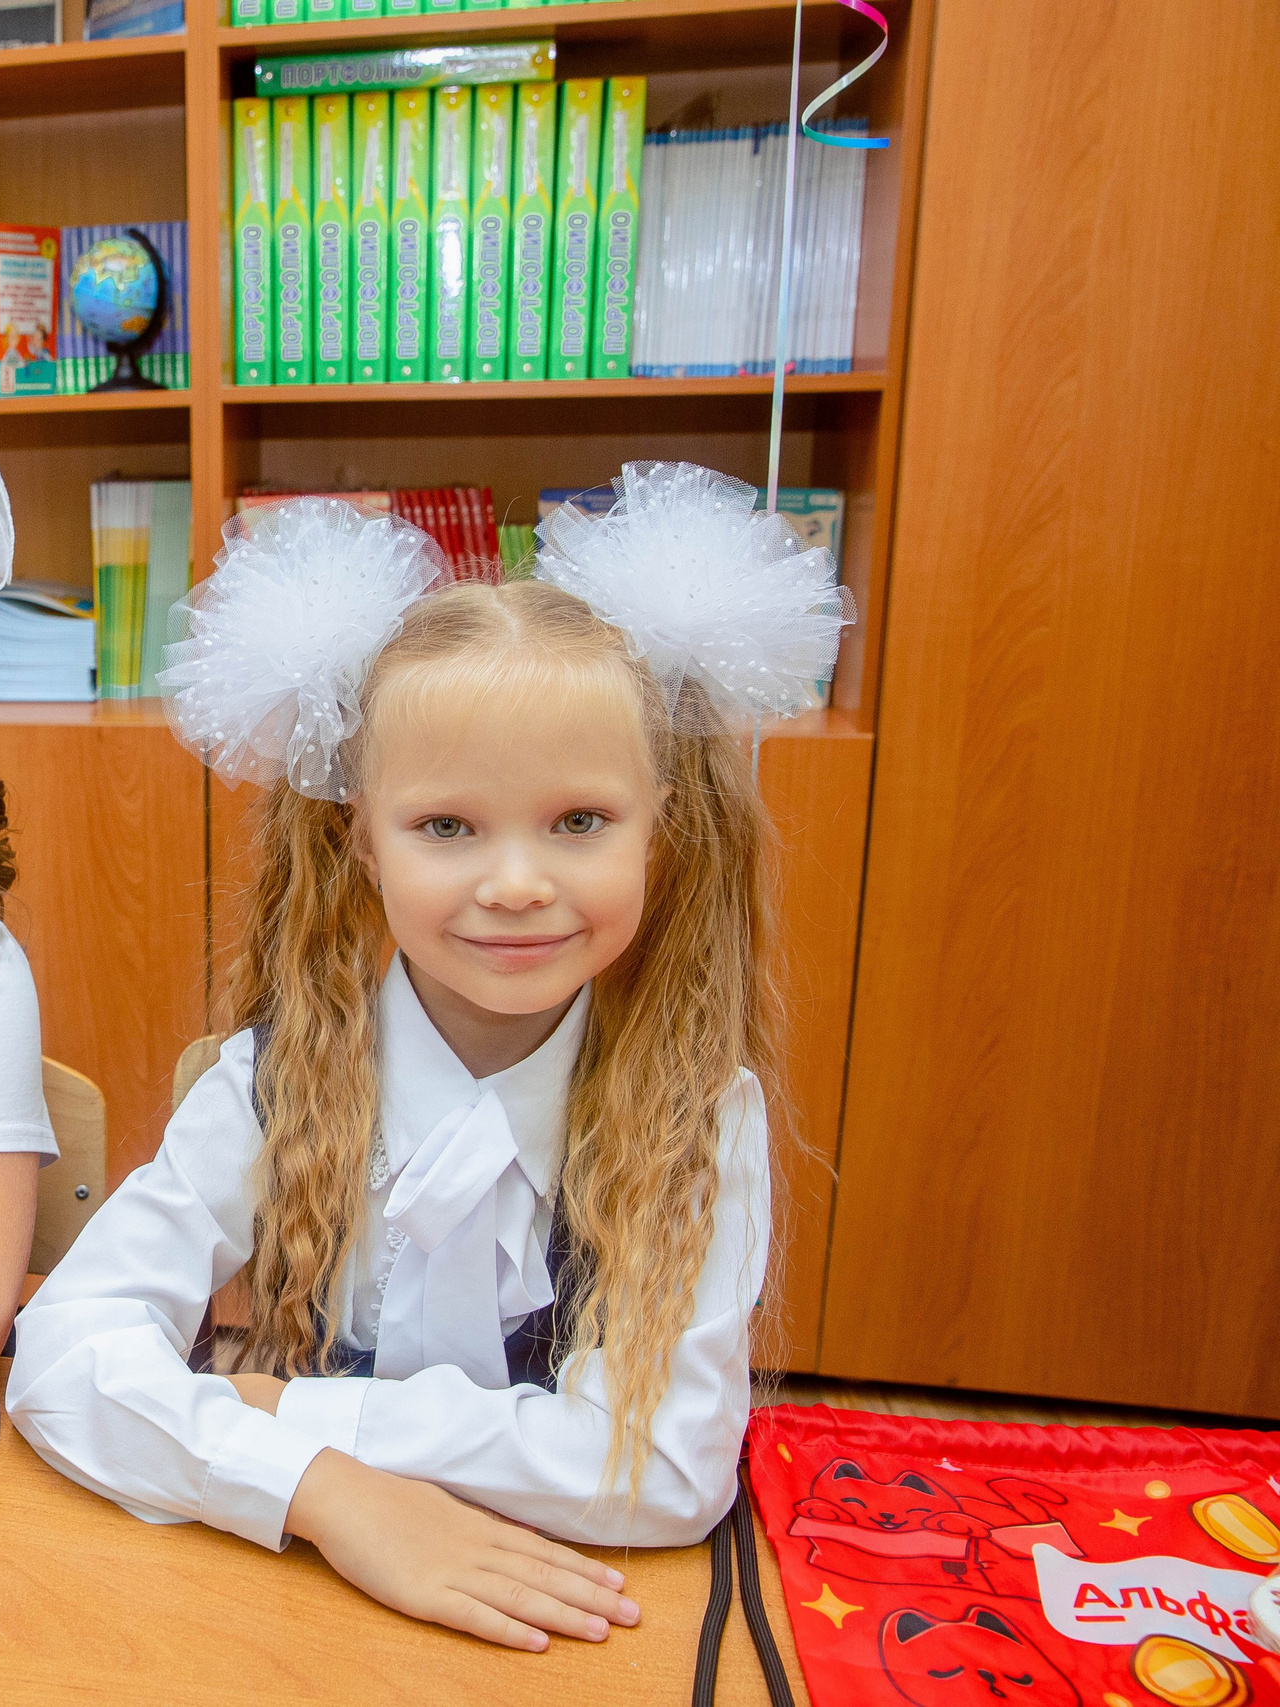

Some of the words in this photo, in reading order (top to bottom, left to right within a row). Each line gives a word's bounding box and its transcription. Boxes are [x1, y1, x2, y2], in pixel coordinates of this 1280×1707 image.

[281, 57, 423, 87] ПОРТФОЛИО
[243, 226, 263, 361] ПОРТФОЛИО
[282, 225, 302, 360] ПОРТФОЛИО
[321, 223, 341, 360] ПОРТФОЛИО
[359, 221, 380, 359] ПОРТФОЛИО
[397, 219, 419, 359] ПОРТФОЛИО
[478, 216, 500, 356] ПОРТФОЛИО
[518, 214, 542, 355] ПОРТФОЛИО
[562, 213, 587, 355] ПОРТФОЛИО
[604, 212, 630, 354] ПОРТФОЛИО
